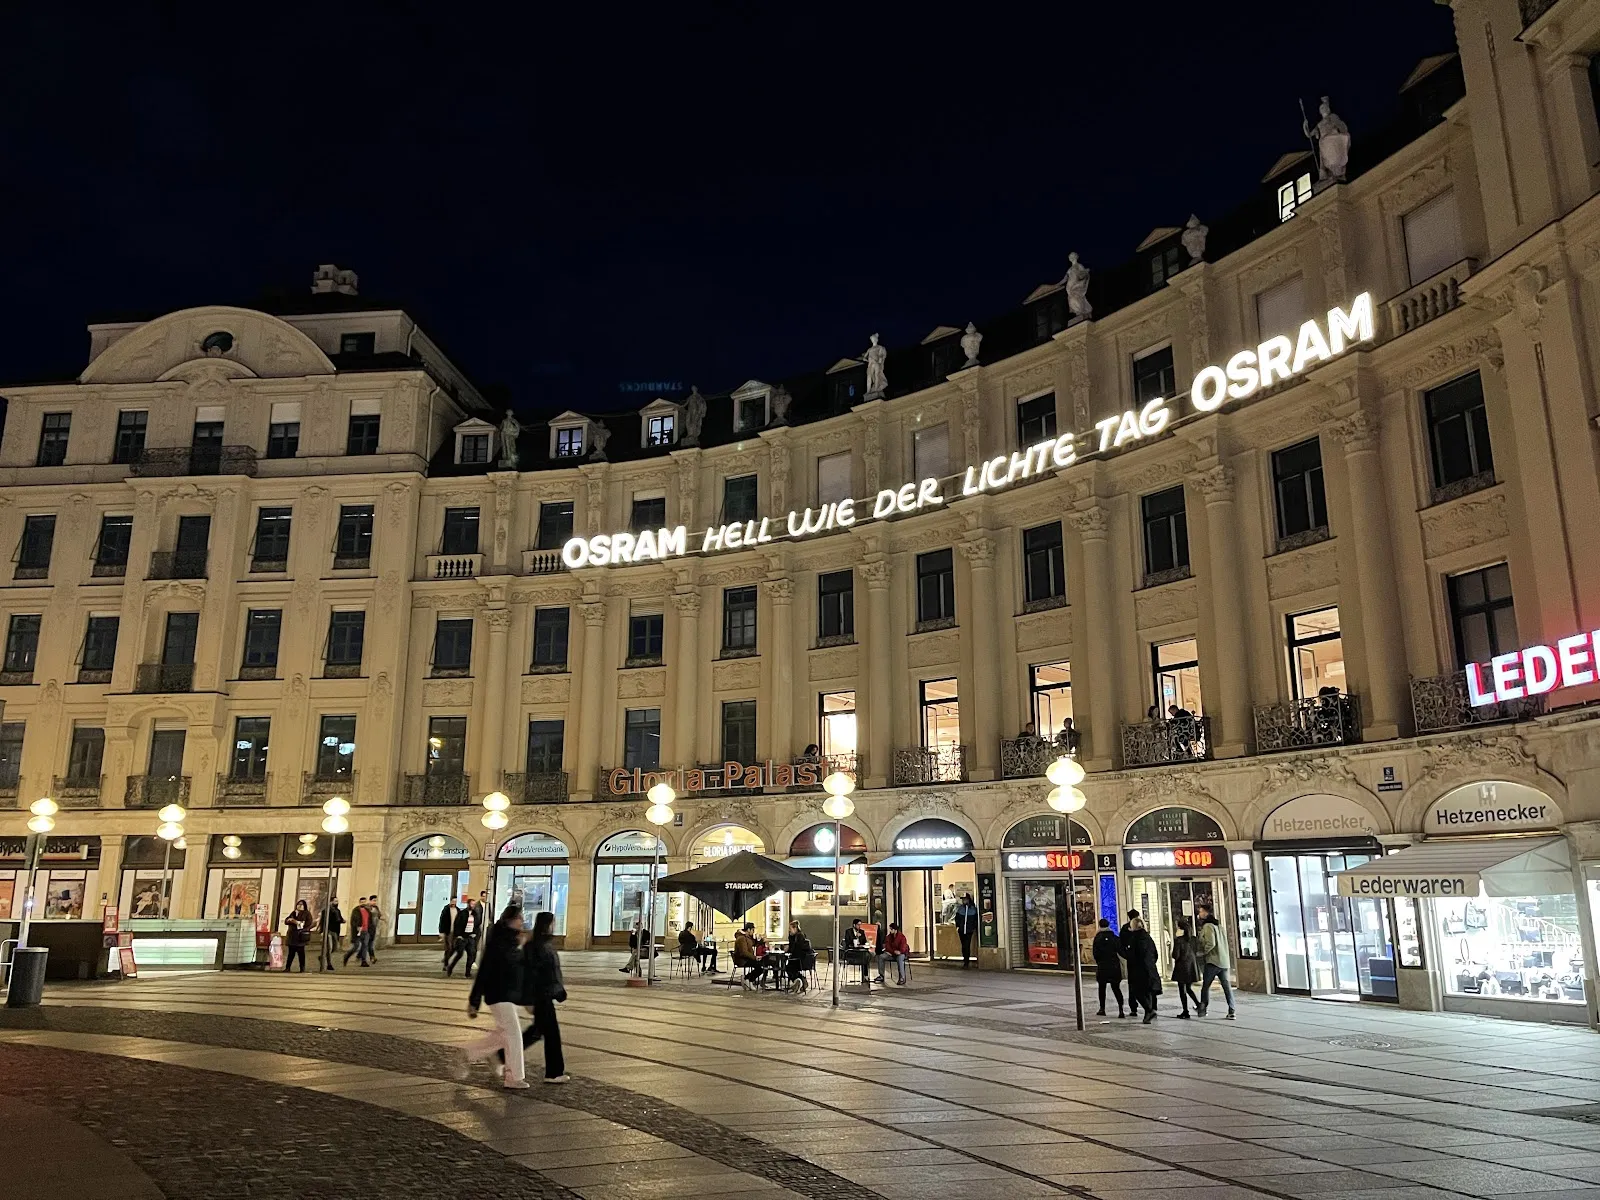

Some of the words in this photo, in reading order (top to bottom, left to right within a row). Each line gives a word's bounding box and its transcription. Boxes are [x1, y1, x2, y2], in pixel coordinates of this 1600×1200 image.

[562, 526, 686, 569] OSRAM
[702, 516, 772, 552] HELL
[787, 498, 856, 537] WIE
[872, 477, 944, 519] DER
[961, 431, 1077, 497] LICHTE
[1095, 396, 1171, 452] TAG
[1191, 291, 1376, 412] OSRAM
[609, 758, 833, 795] Gloria-Palast
[1437, 803, 1546, 825] Hetzenecker
[1273, 814, 1365, 833] Hetzenecker
[512, 844, 565, 856] HypoVereinsbank
[896, 836, 963, 850] STARBUCKS
[1103, 855, 1111, 867] 8
[1131, 849, 1212, 867] GameStop
[725, 882, 763, 890] STARBUCKS
[1350, 876, 1465, 895] Lederwaren
